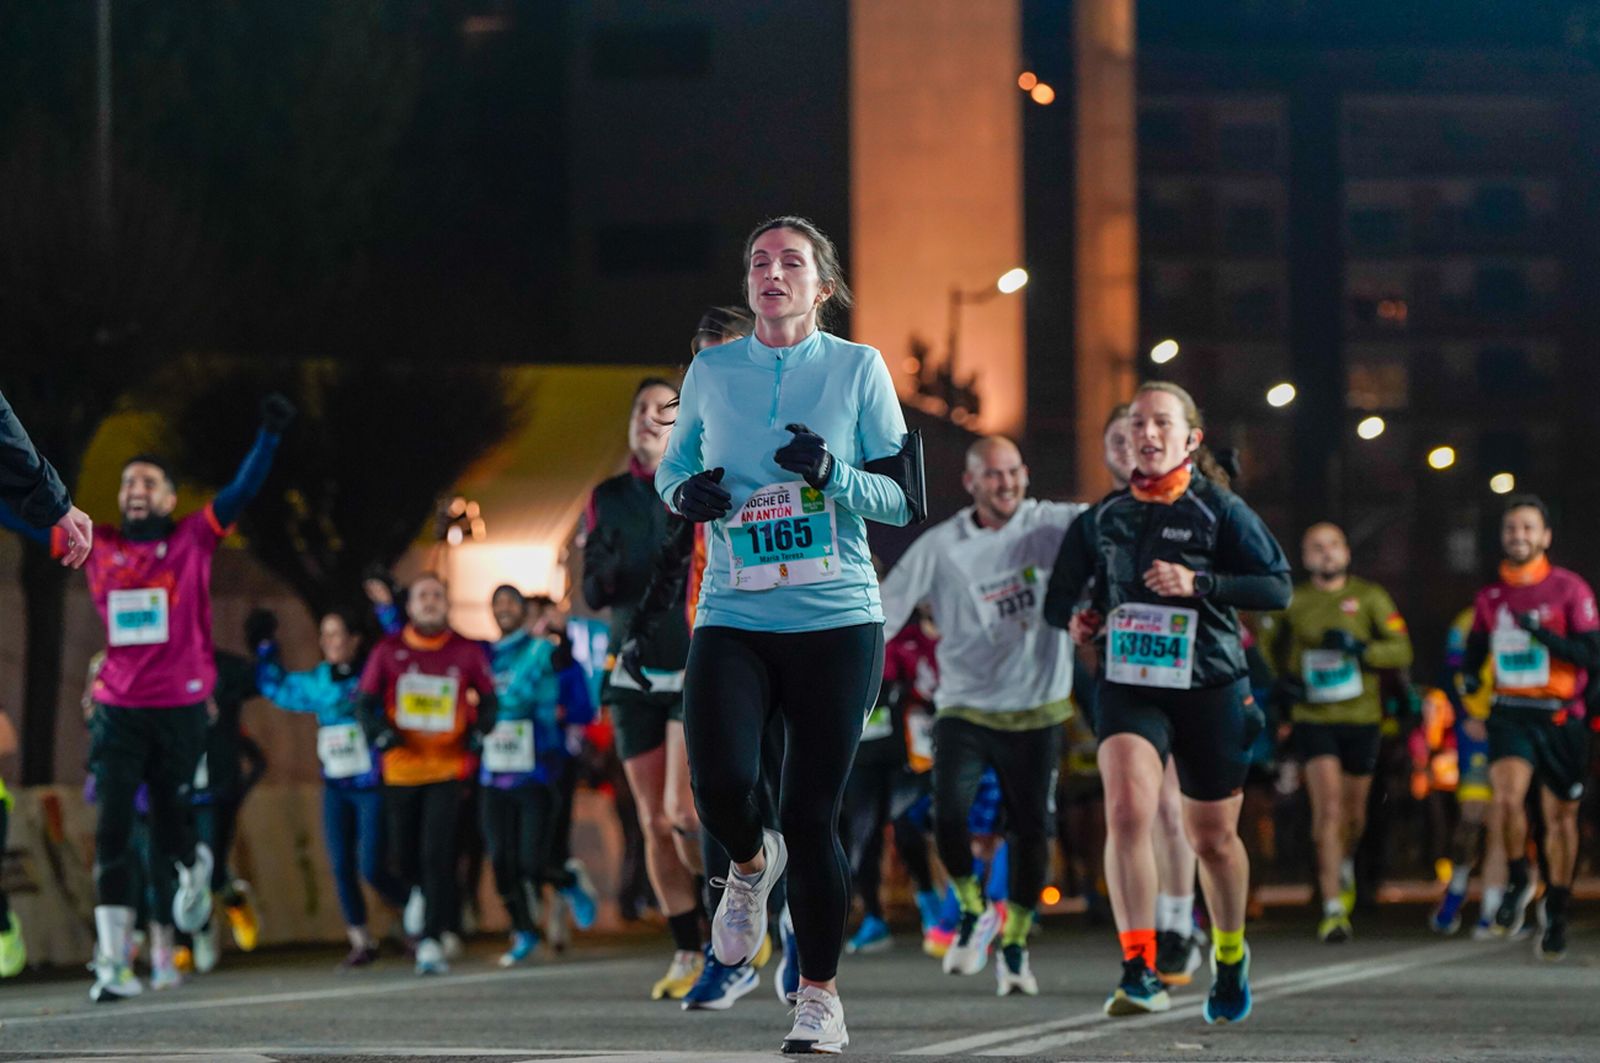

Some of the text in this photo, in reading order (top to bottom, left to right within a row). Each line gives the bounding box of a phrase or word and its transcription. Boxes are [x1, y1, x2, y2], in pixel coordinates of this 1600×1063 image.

[778, 493, 791, 505] DE
[741, 511, 754, 522] AN
[747, 517, 813, 554] 1165
[1119, 632, 1181, 659] 13854
